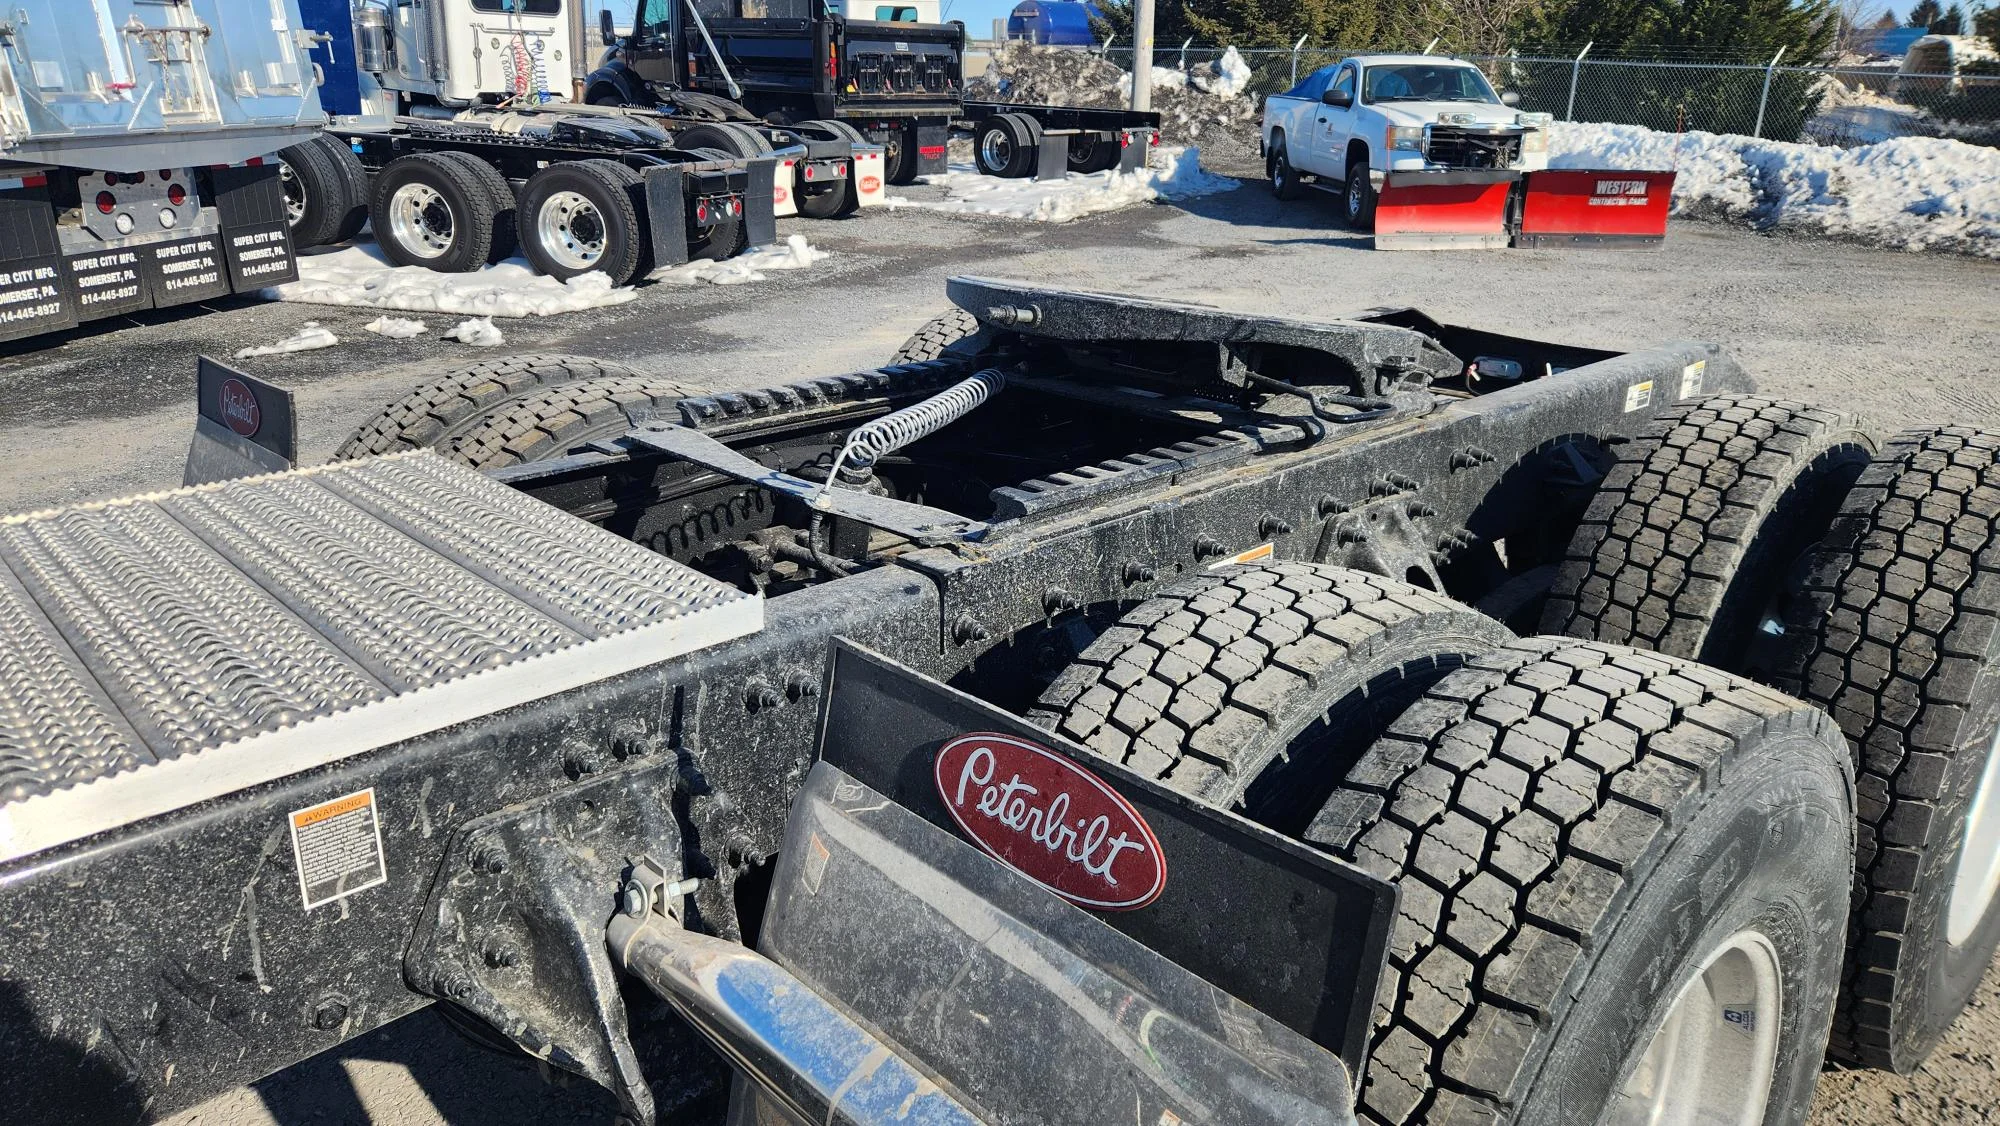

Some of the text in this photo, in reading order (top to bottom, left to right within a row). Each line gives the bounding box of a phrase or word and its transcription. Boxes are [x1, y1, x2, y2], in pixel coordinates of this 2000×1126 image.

[1596, 181, 1648, 195] WESTERN
[233, 231, 285, 247] SUPER CITY MFG.
[156, 240, 215, 258] SUPER CITY MFG.
[239, 246, 285, 262] SOMERSET, PA.
[72, 252, 138, 271] SUPER CITY MFG.
[162, 257, 215, 274] SOMERSET, PA.
[242, 260, 288, 277] 814-445-8927
[12, 269, 33, 283] CITY
[34, 266, 57, 280] MFG.
[79, 269, 137, 288] SOMERSET, PA.
[165, 272, 217, 290] 814-445-8927
[41, 285, 58, 297] PA.
[81, 285, 138, 305] 814-445-8927
[0, 302, 60, 323] 14-445-8927
[223, 385, 256, 425] Peterbilt
[312, 798, 362, 818] WARNING
[957, 747, 1145, 885] Peterbilt
